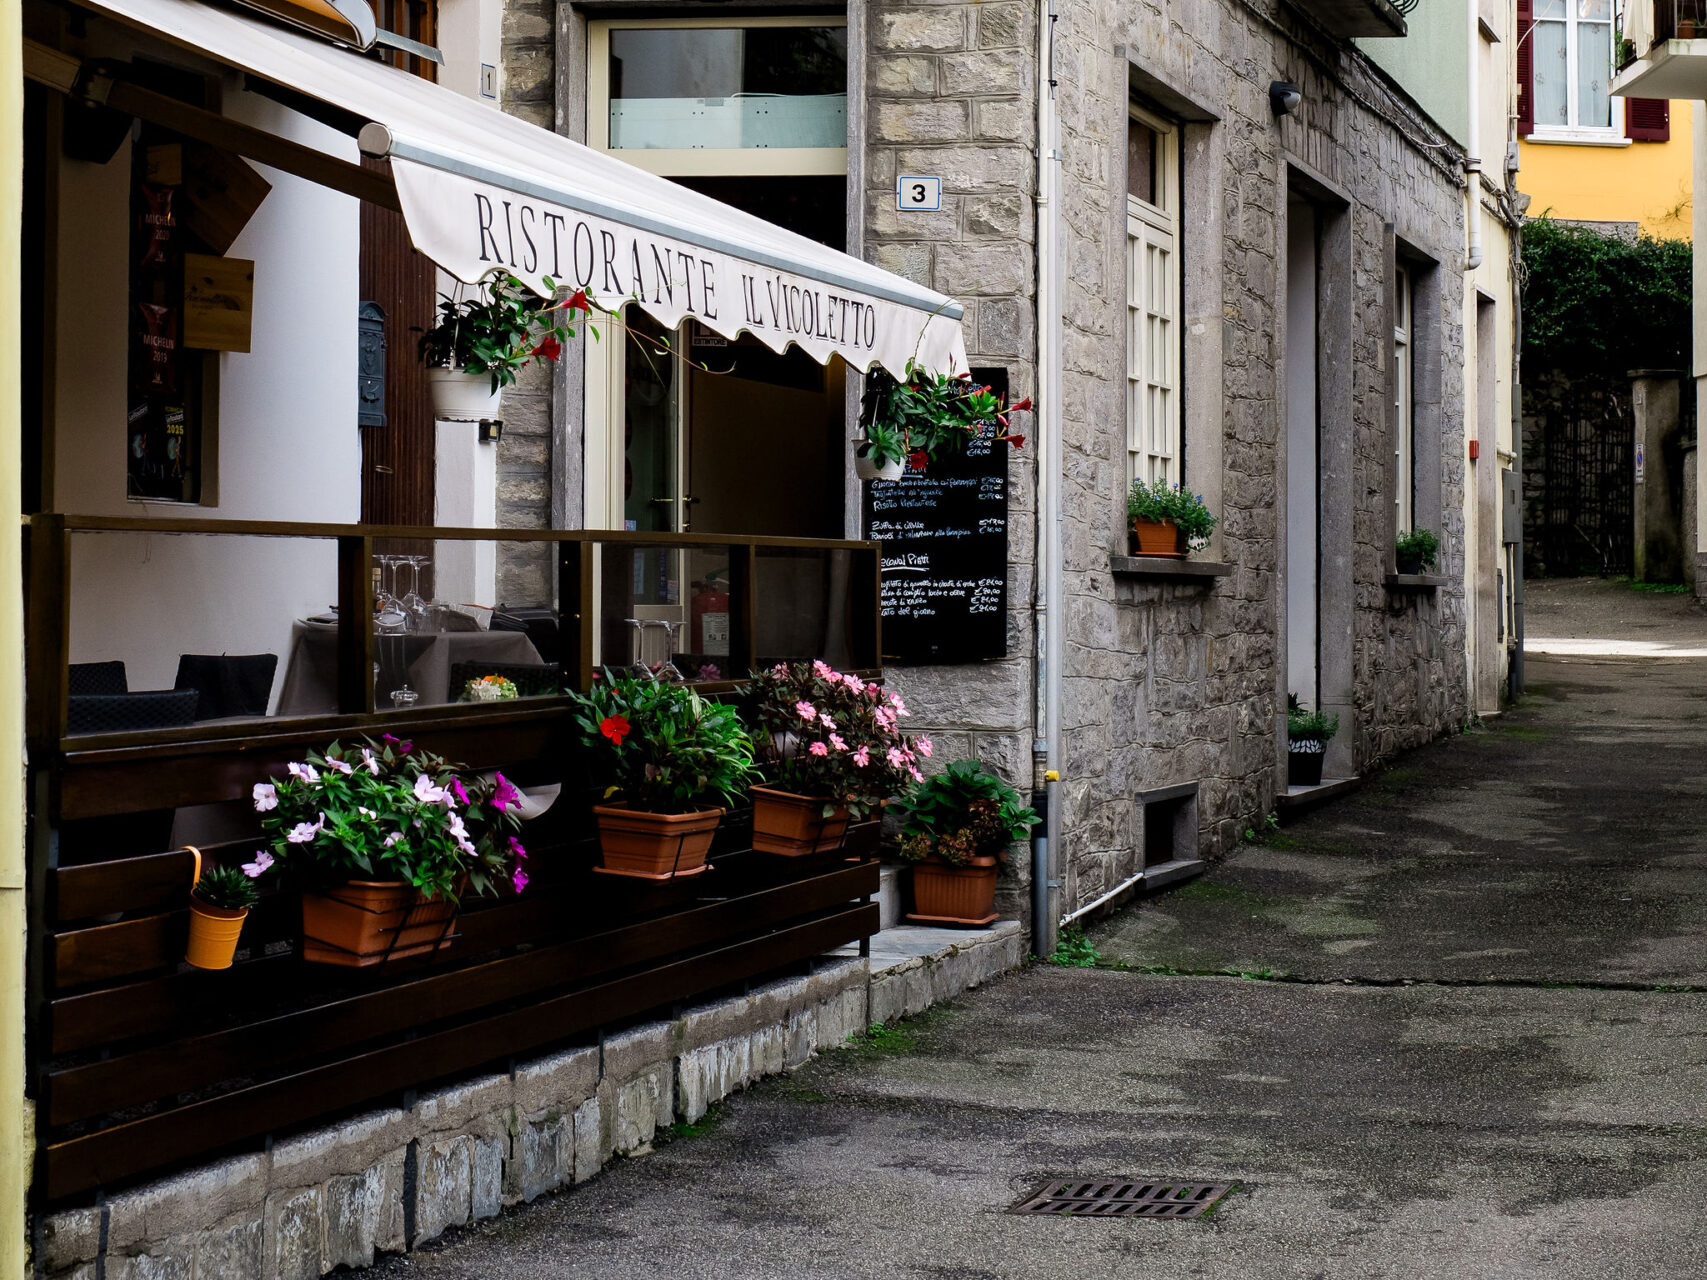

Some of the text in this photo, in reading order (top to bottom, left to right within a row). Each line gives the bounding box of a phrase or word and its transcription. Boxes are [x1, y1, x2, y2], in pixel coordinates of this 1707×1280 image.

[487, 71, 491, 91] 1
[911, 183, 926, 203] 3
[474, 193, 876, 352] RISTORANTE IL VICOLETTO
[143, 333, 175, 350] MICHELIN
[166, 424, 184, 435] 2025
[873, 499, 898, 512] Risotto
[869, 531, 894, 540] Ravioli
[881, 552, 930, 567] econdi Piatti
[897, 606, 911, 616] del
